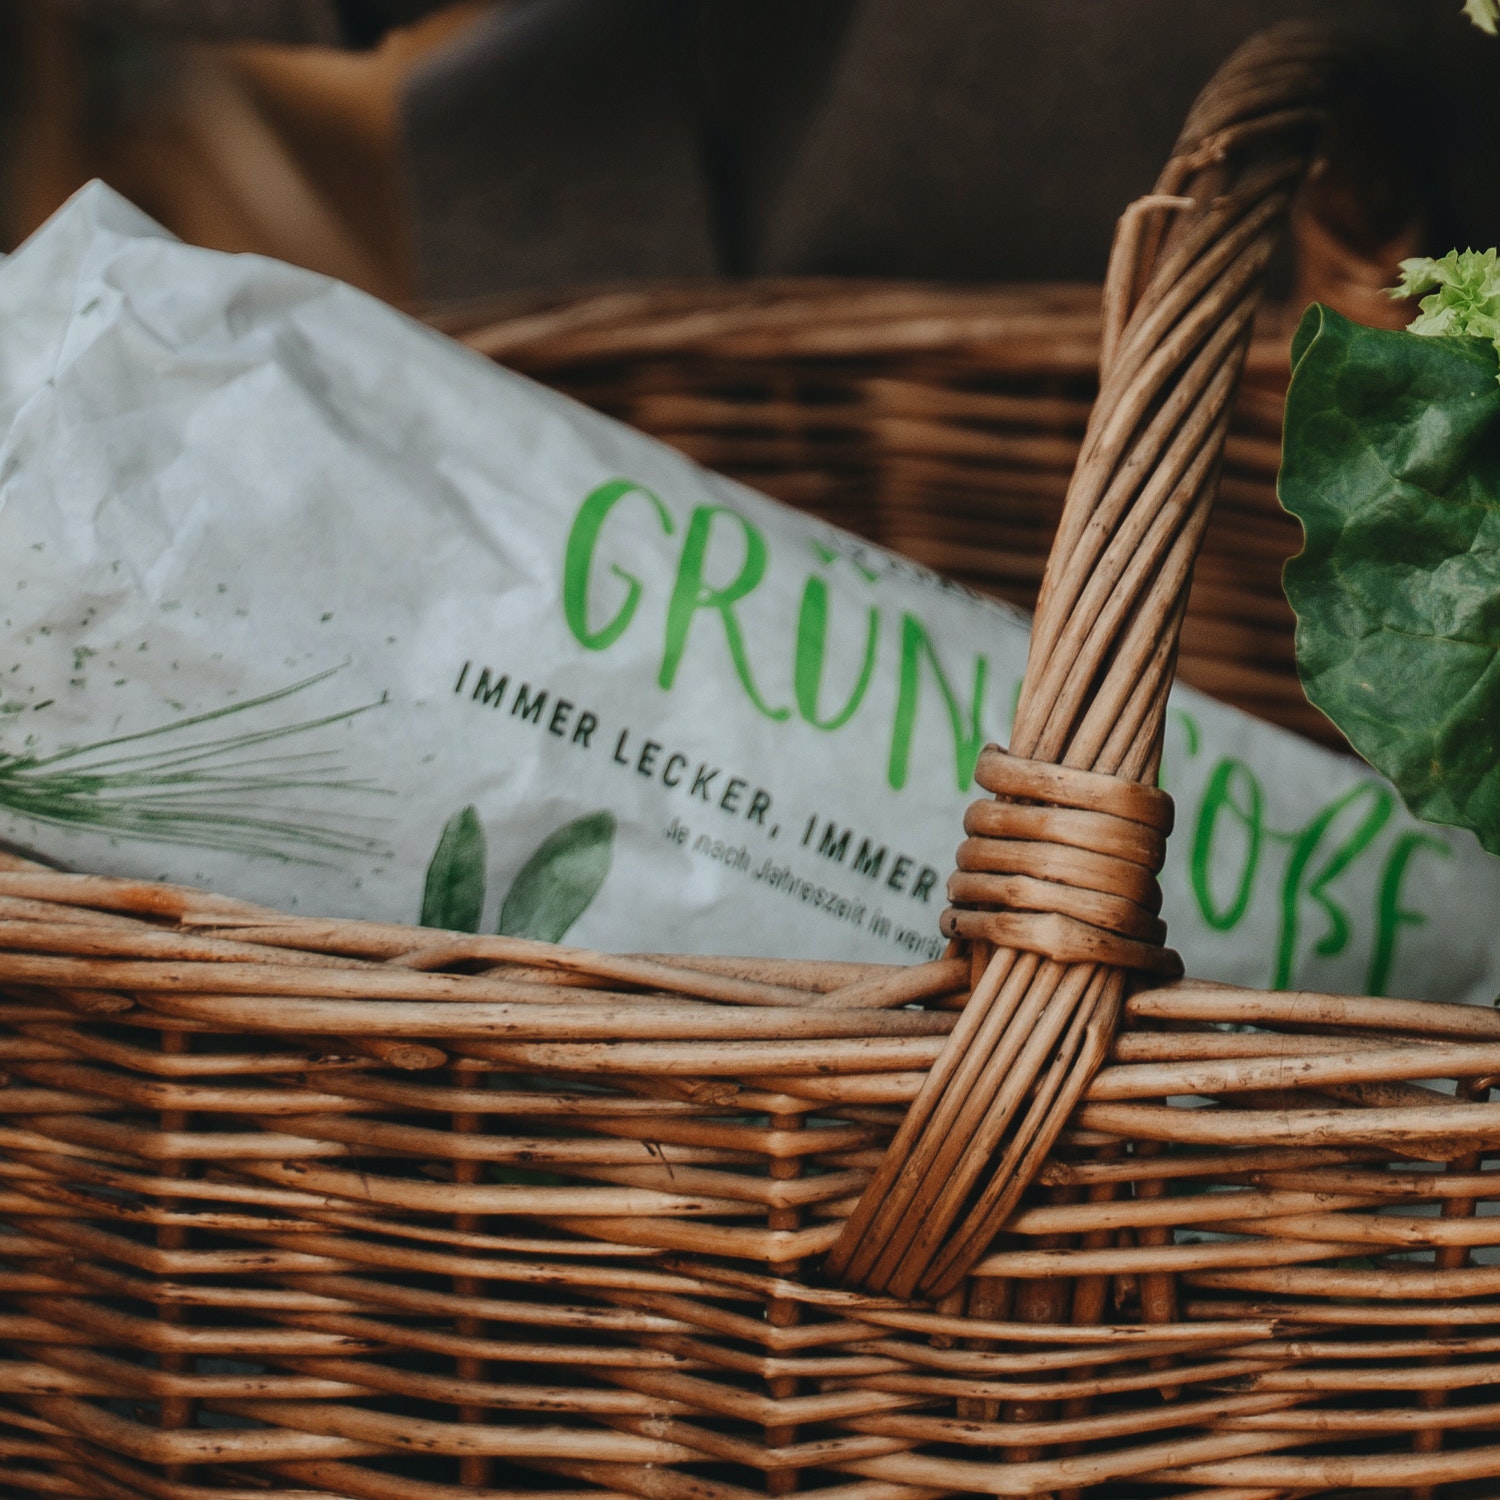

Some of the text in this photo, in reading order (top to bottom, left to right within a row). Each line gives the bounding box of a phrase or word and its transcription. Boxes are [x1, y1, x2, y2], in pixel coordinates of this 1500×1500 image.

[563, 479, 1022, 794] GRÜN
[454, 660, 939, 904] IMMER LECKER, IMMER
[693, 833, 750, 872] nach
[754, 857, 868, 925] Jahreszeit
